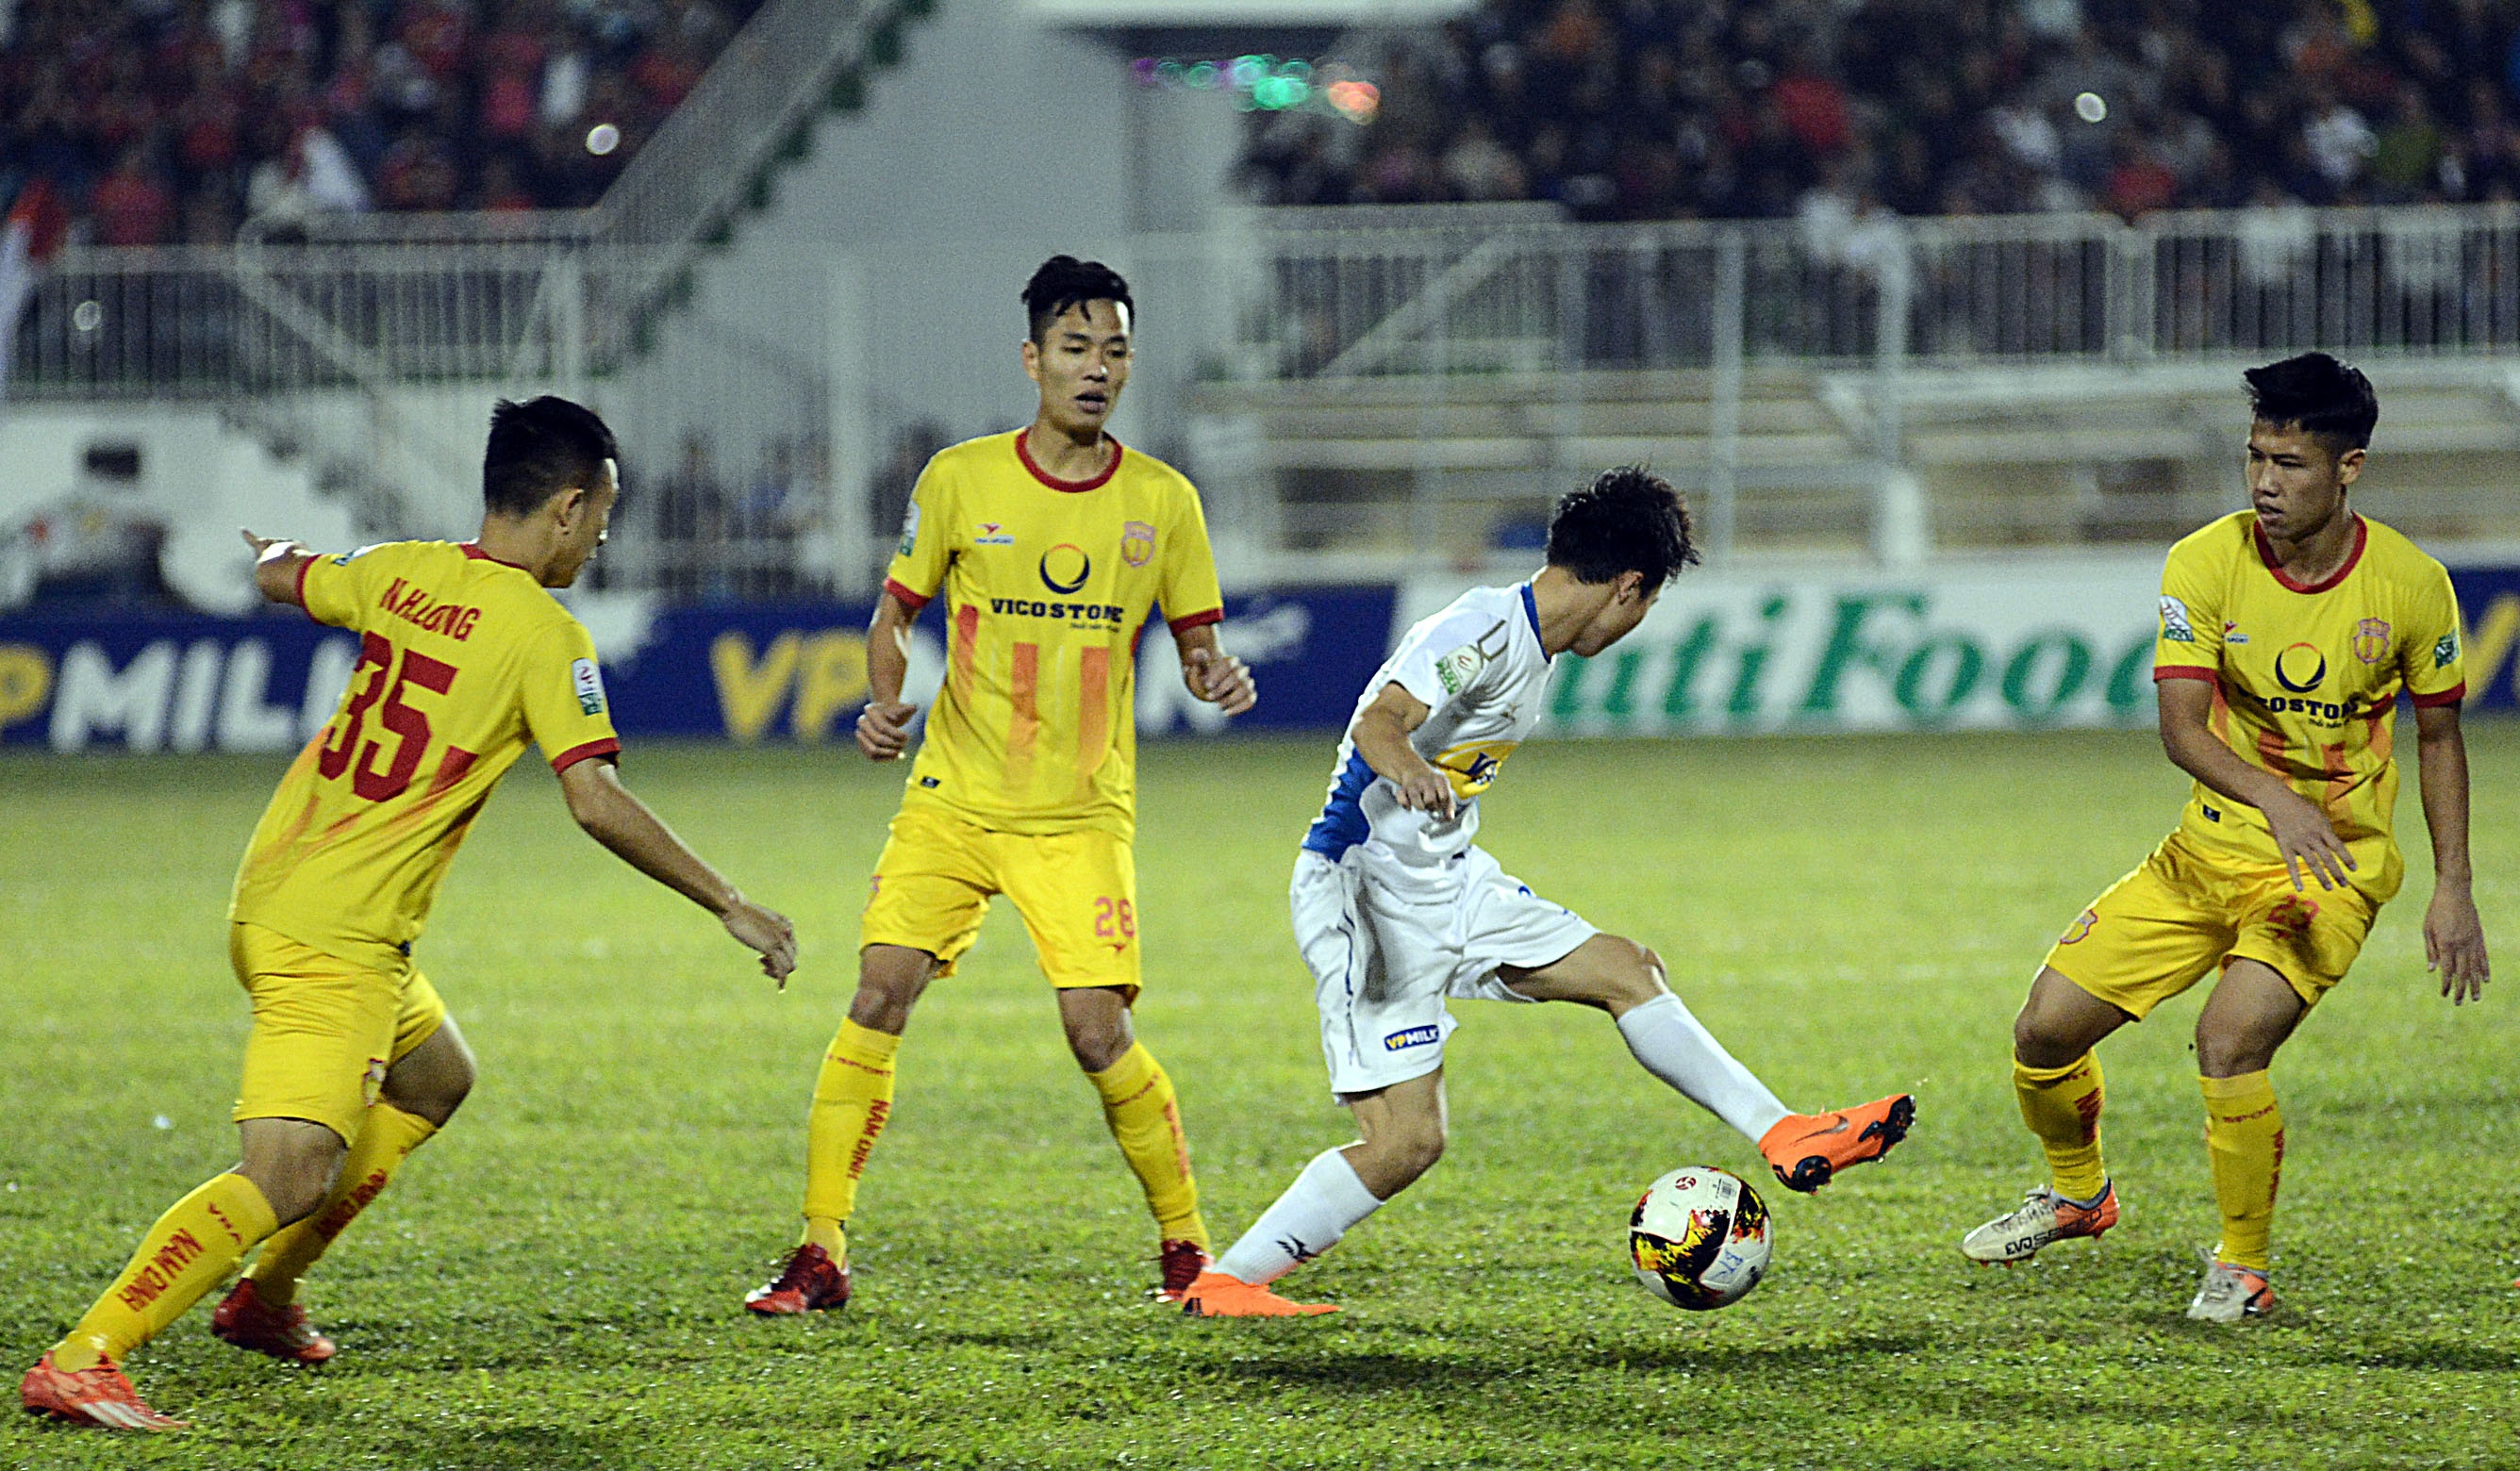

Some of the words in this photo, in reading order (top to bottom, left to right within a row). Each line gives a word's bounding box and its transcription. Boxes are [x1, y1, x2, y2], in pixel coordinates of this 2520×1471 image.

[1549, 592, 2162, 719] utiFoo
[2456, 587, 2520, 707] V
[318, 630, 460, 803] 35
[1094, 896, 1136, 938] 28
[152, 1227, 206, 1281] NAM
